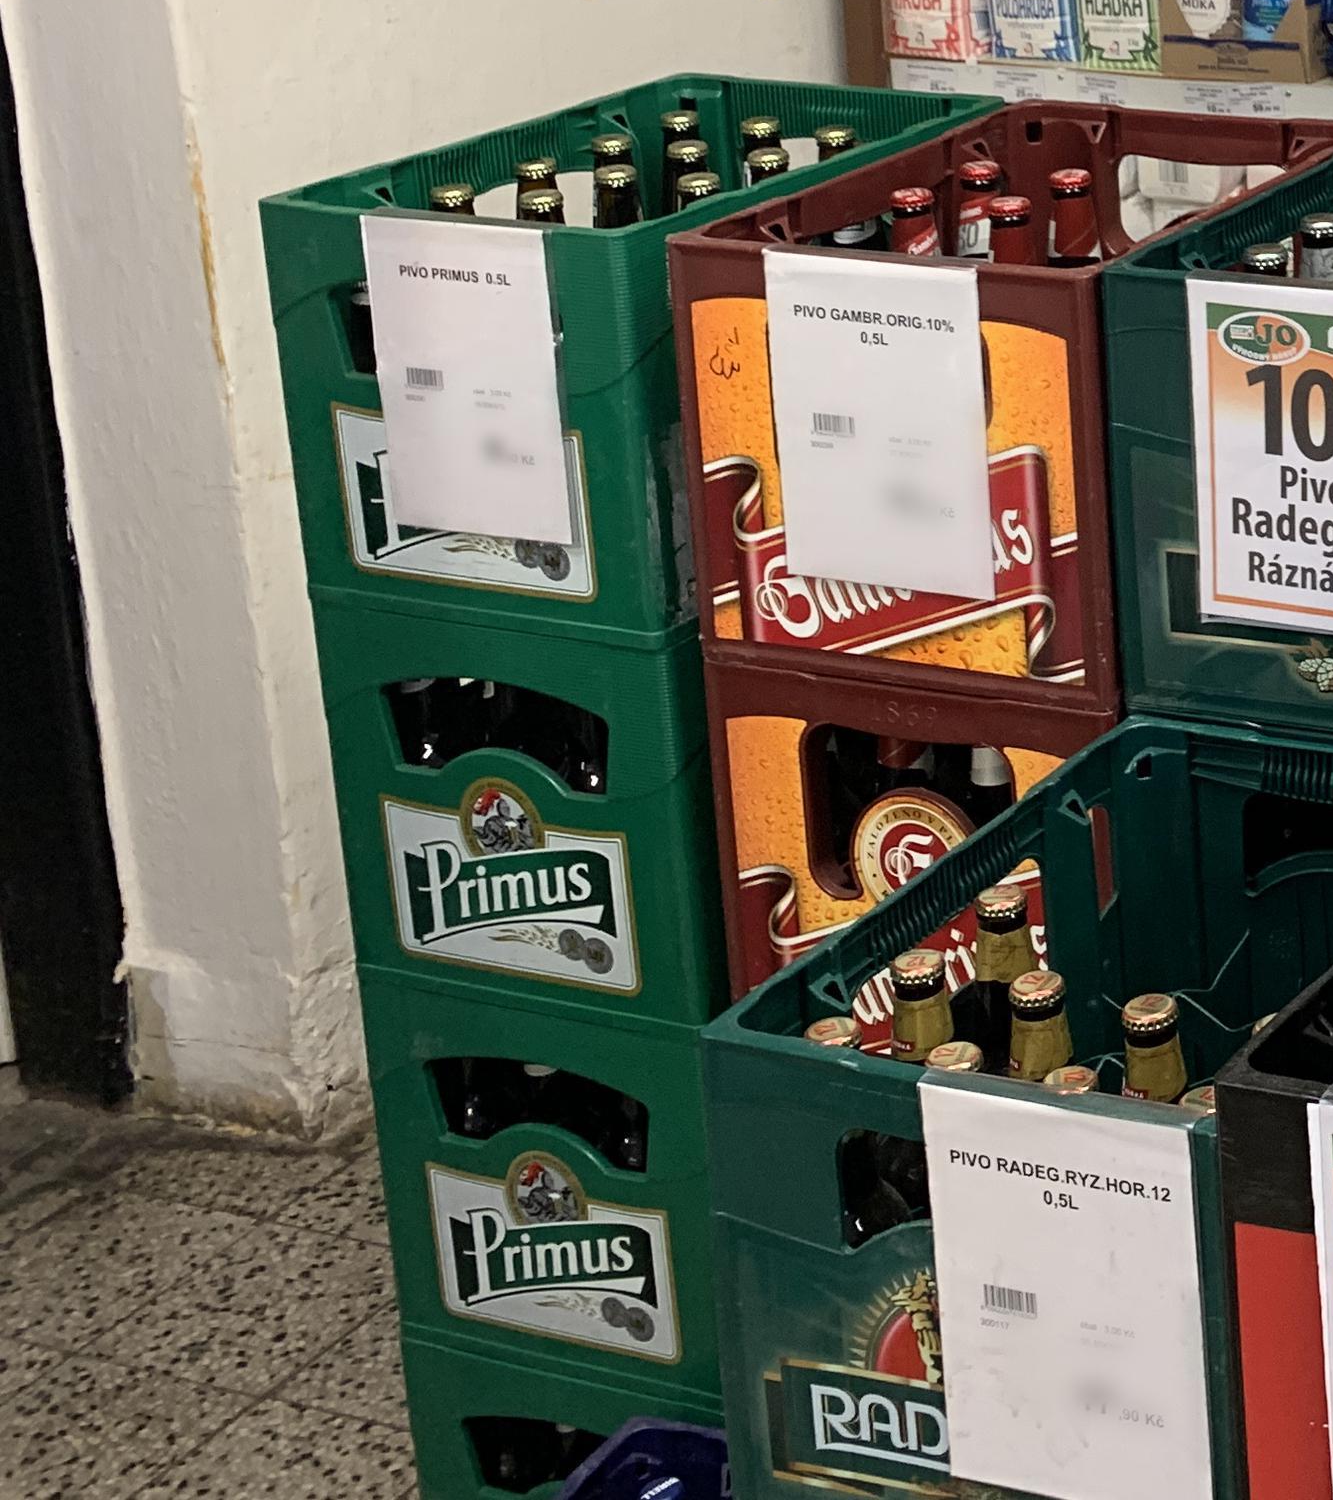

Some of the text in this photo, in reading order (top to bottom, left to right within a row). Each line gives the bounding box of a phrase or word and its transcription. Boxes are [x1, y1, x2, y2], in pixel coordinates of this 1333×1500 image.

[399, 263, 430, 280] PIVO
[433, 266, 479, 284] PRIMUS
[793, 304, 955, 335] PIVO GAMBR.ORIG.10%
[861, 331, 889, 348] 0,5L
[1255, 321, 1298, 348] JO
[420, 840, 592, 942] Primus
[950, 1150, 1171, 1203] PIVO RADEG.RYZ.HOR.12
[1043, 1191, 1079, 1210] 0,5L
[464, 1208, 634, 1305] Primus
